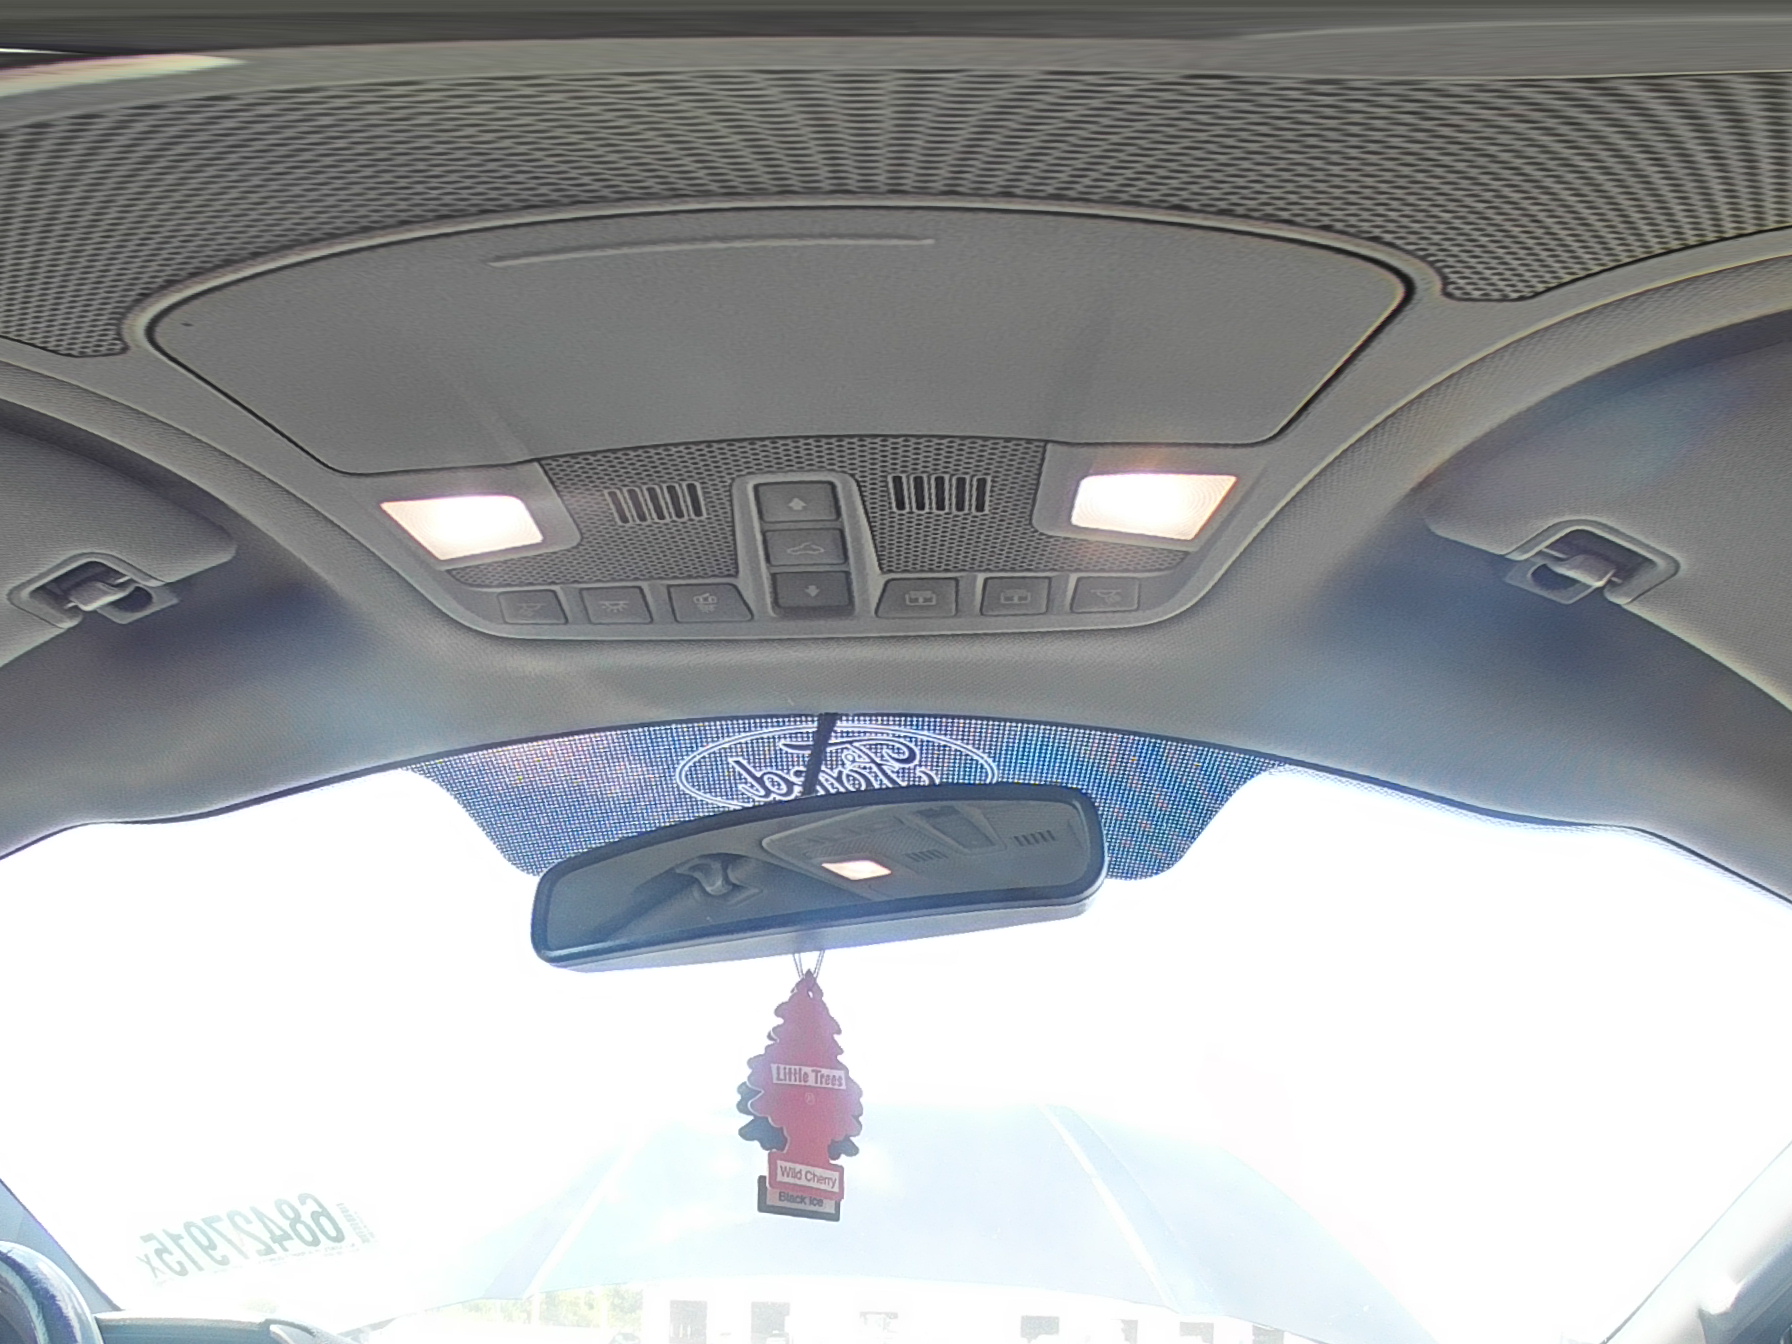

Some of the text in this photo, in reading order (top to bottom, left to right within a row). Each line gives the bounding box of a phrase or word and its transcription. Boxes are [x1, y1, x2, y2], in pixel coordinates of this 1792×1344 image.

[776, 1066, 844, 1087] Little Trees
[779, 1165, 837, 1189] Wild Cherry
[778, 1191, 824, 1208] Black Ice
